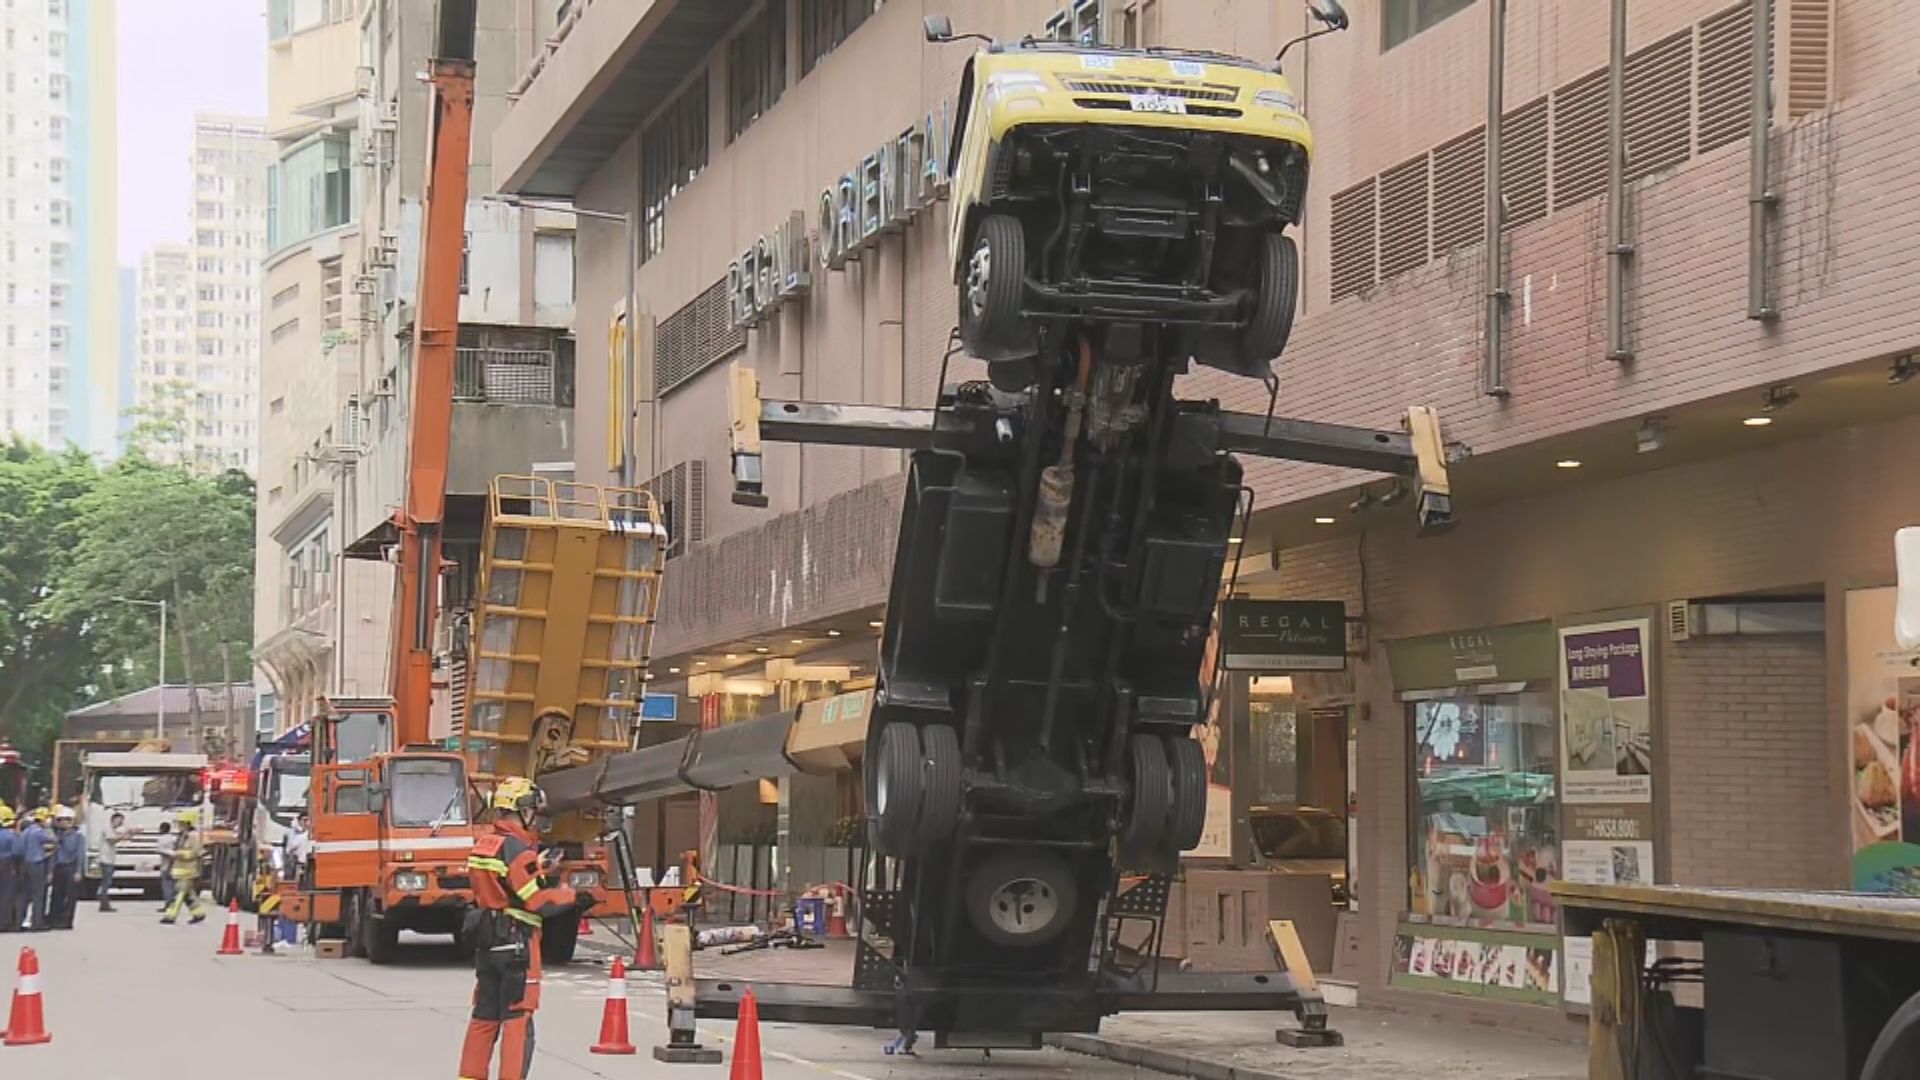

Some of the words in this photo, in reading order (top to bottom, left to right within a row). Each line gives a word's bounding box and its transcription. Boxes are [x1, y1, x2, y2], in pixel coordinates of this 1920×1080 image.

[728, 212, 808, 330] REGAL
[1239, 615, 1329, 629] REGAL
[1609, 641, 1640, 657] Package
